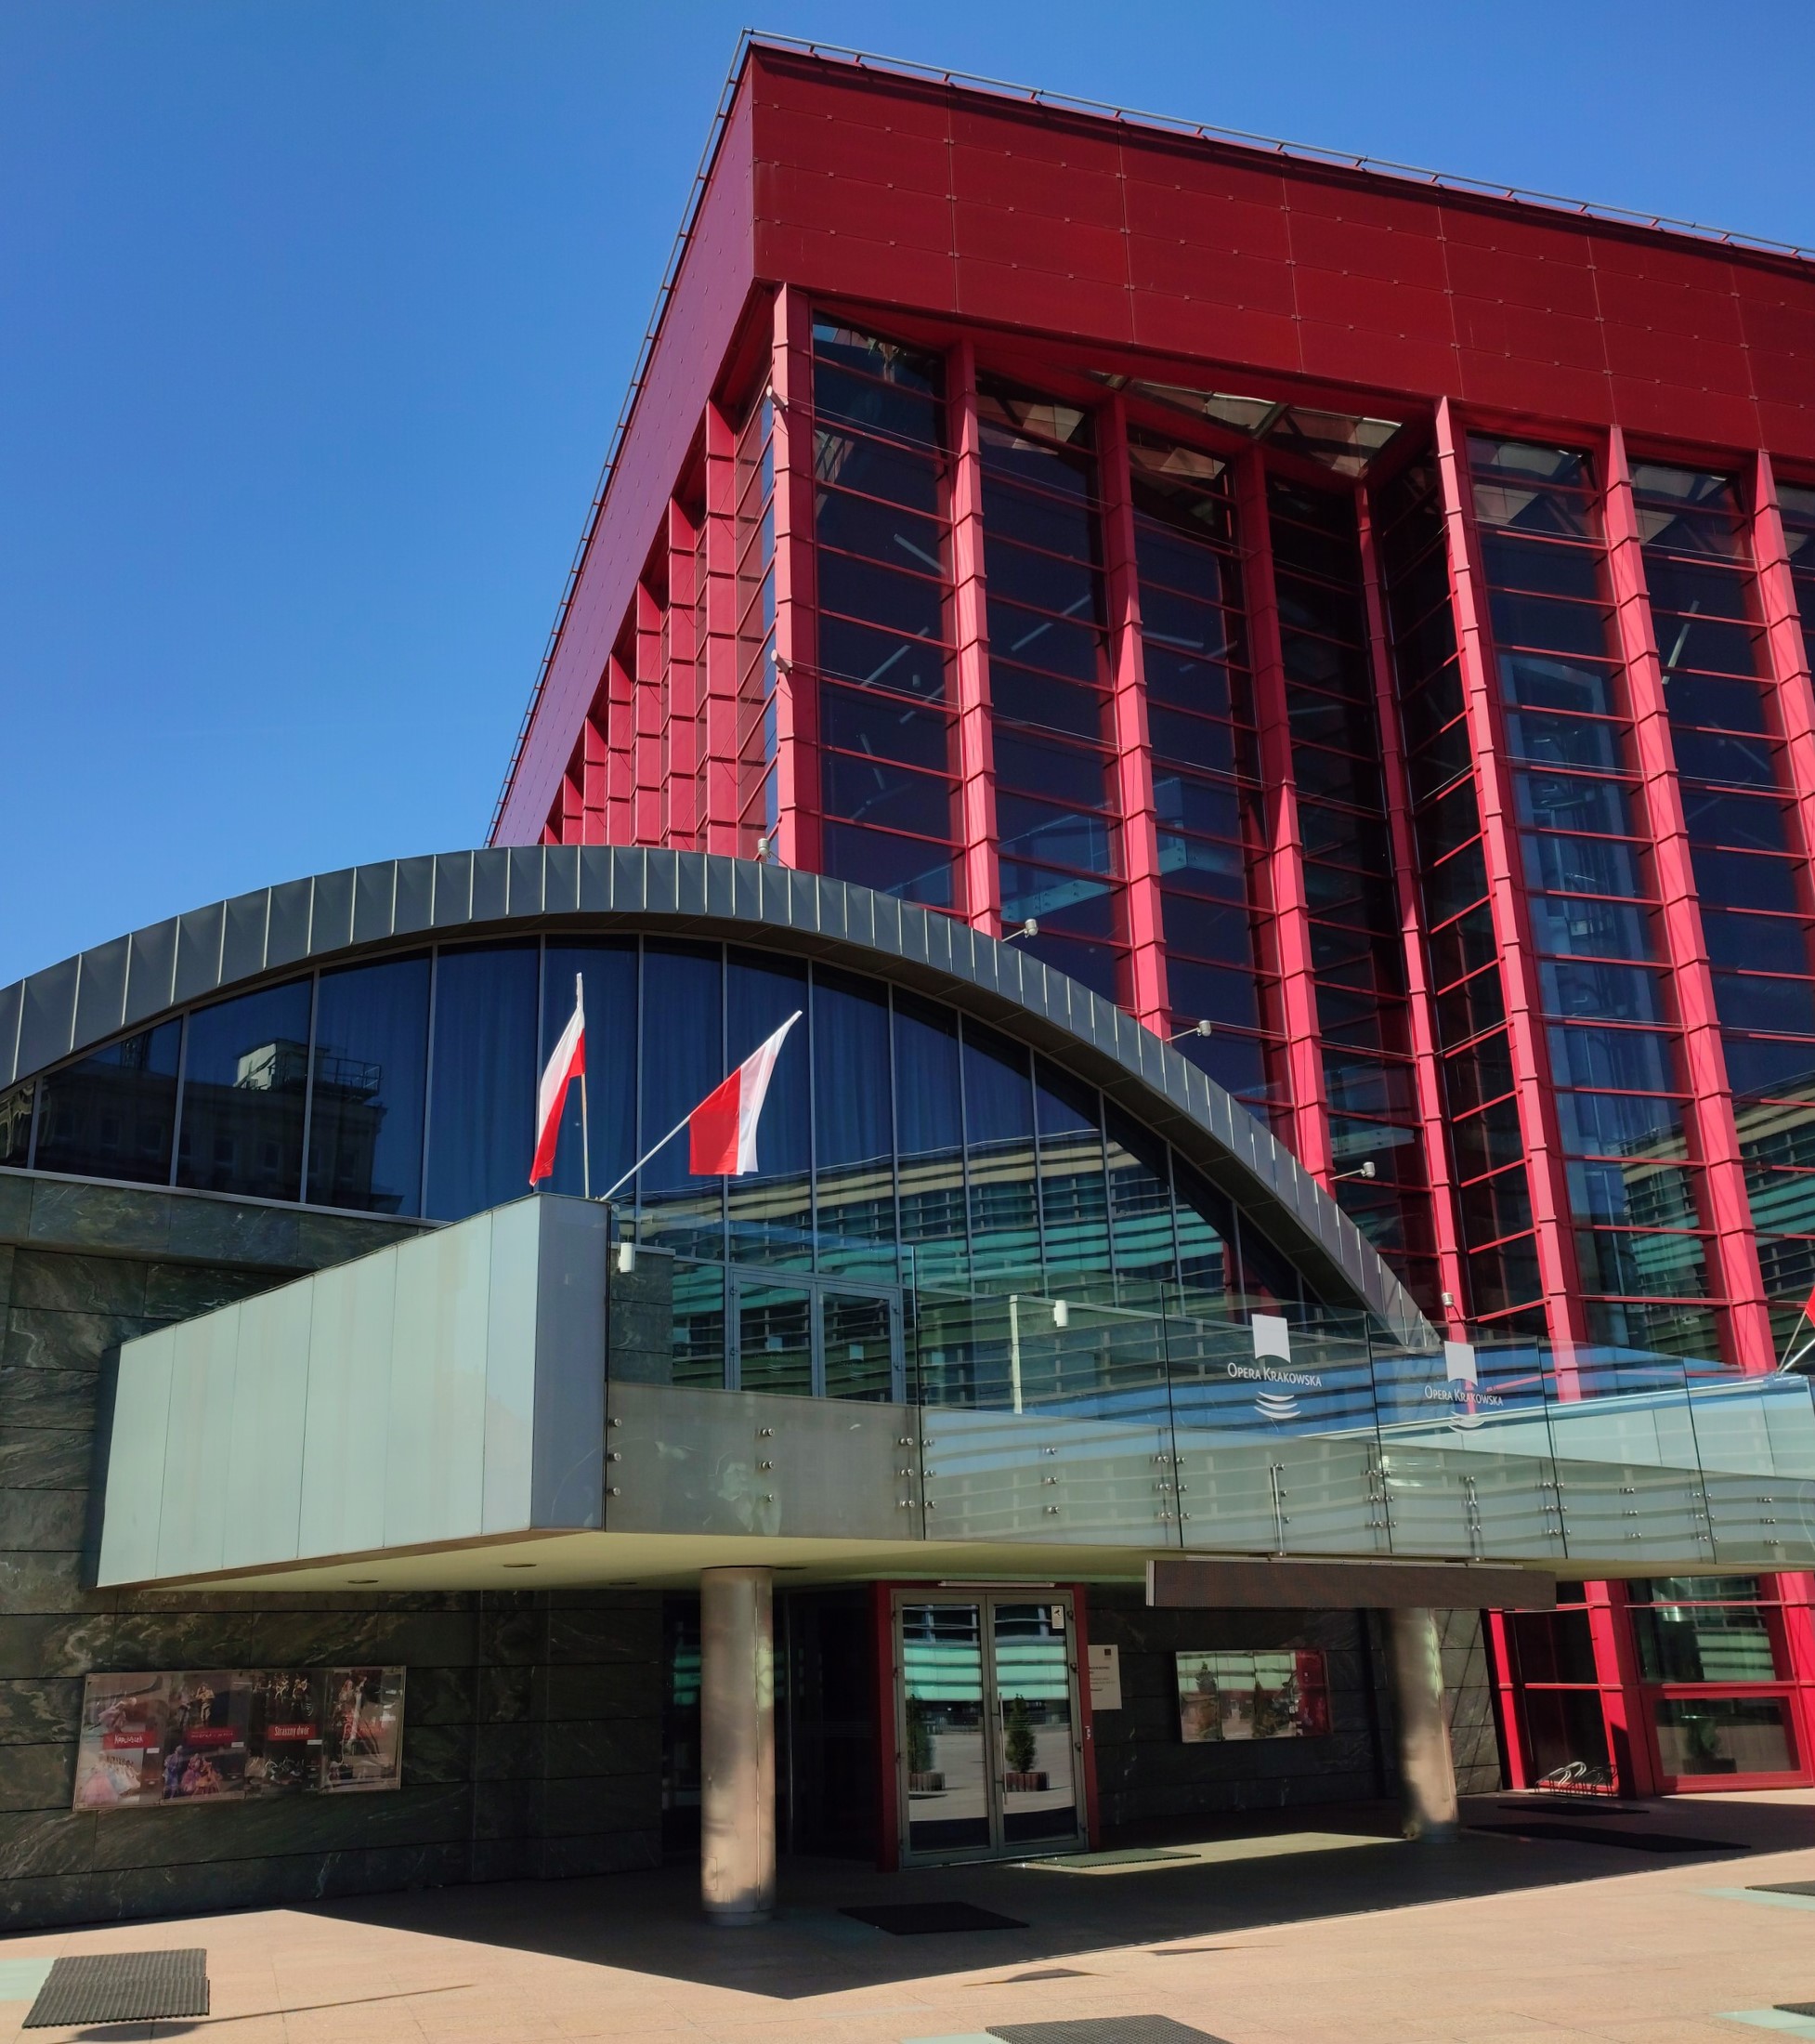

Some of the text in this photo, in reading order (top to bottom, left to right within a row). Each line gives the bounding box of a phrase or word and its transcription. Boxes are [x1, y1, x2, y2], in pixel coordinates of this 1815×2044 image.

[1227, 1362, 1322, 1387] OPERA KRAKOWSKA
[1424, 1384, 1504, 1407] OPERA KRAKOWSKA
[274, 1726, 296, 1737] Straszny
